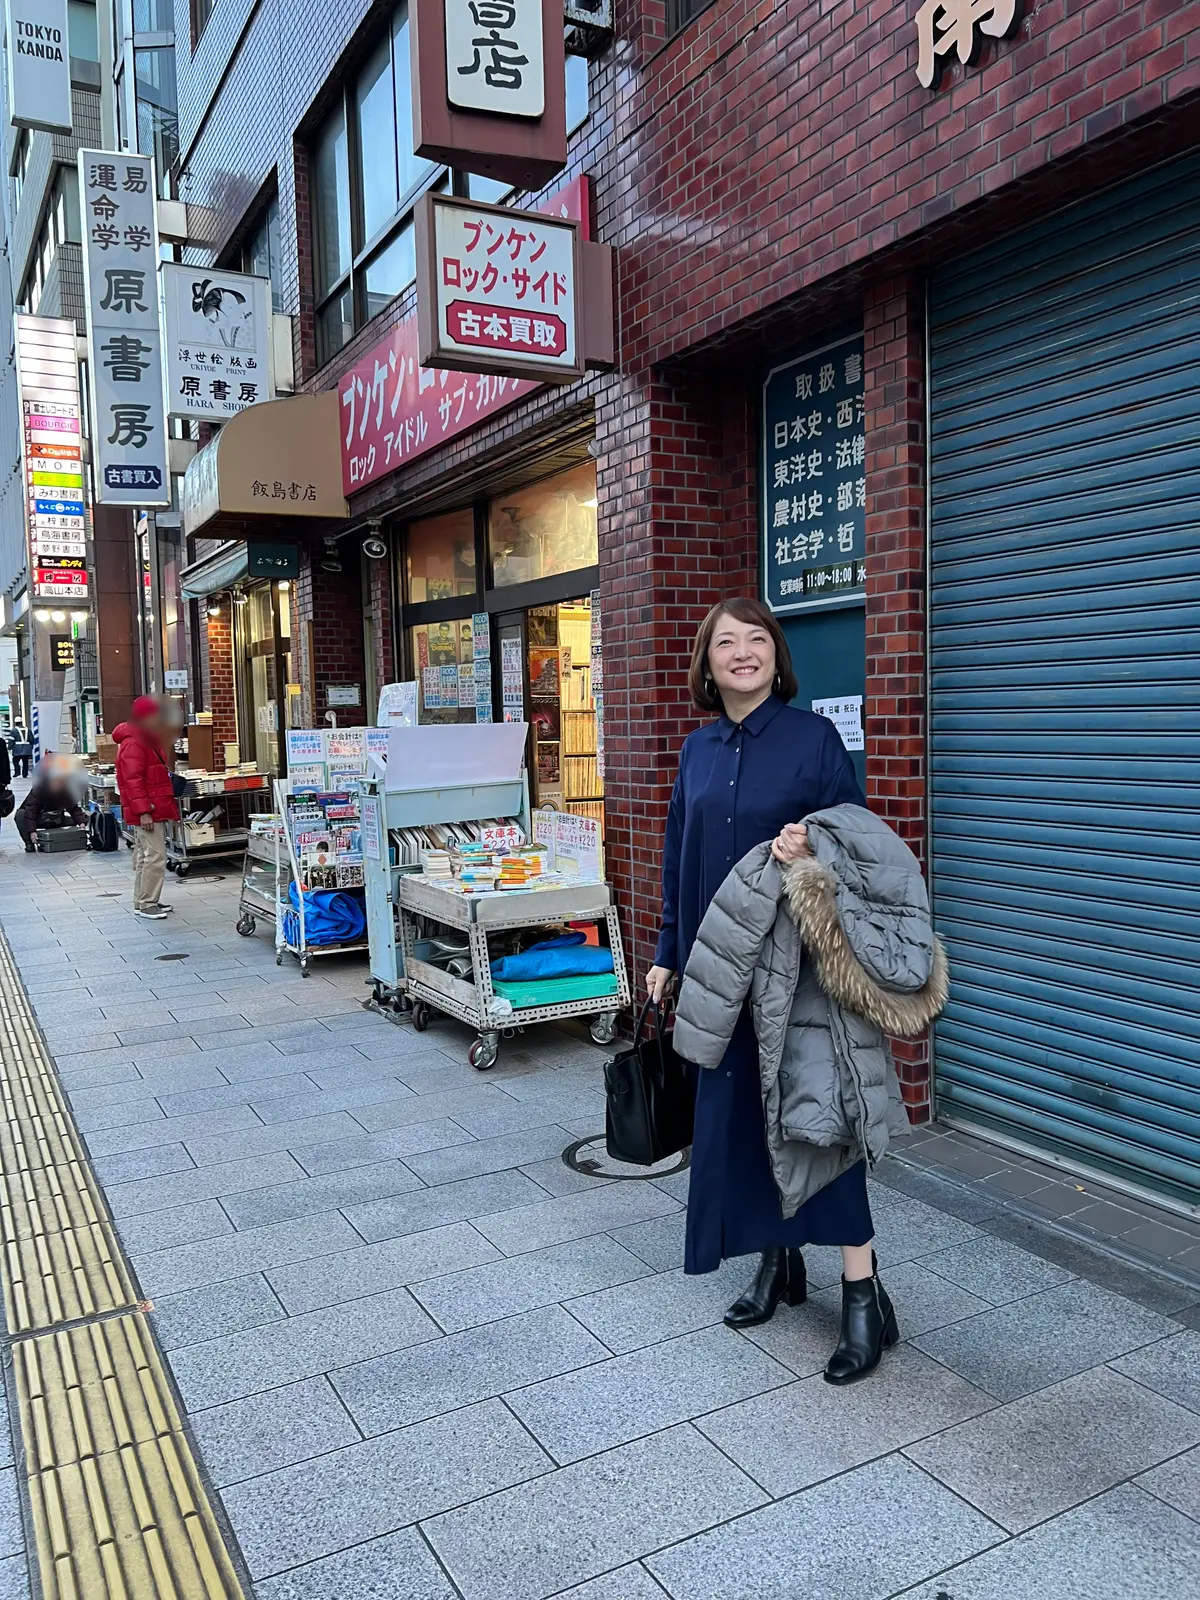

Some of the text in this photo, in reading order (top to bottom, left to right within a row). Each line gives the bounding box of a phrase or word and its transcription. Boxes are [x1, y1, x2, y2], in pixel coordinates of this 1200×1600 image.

[16, 20, 62, 43] TOKYO
[17, 39, 63, 62] KANDA
[89, 164, 121, 250] 運命学
[464, 220, 547, 263] ブンケン
[443, 257, 567, 305] ロック・サイド
[457, 310, 557, 348] 古本買取
[100, 269, 155, 448] 原書房
[178, 348, 258, 369] 浮世絵 版画
[190, 364, 247, 376] UKIYOE PRINT
[179, 376, 259, 403] 原書房
[186, 398, 214, 409] HARA
[35, 419, 75, 430] BOURGIE
[350, 444, 376, 484] ロック
[384, 411, 428, 465] アイドル
[108, 468, 161, 484] 古書買入
[39, 488, 79, 499] みわ書房
[251, 480, 317, 501] 飯島書店
[44, 586, 84, 596] 高山本店
[442, 667, 456, 676] ROCK
[537, 813, 551, 822] SALE
[579, 818, 596, 832] 文庫本
[485, 827, 517, 840] 文庫本
